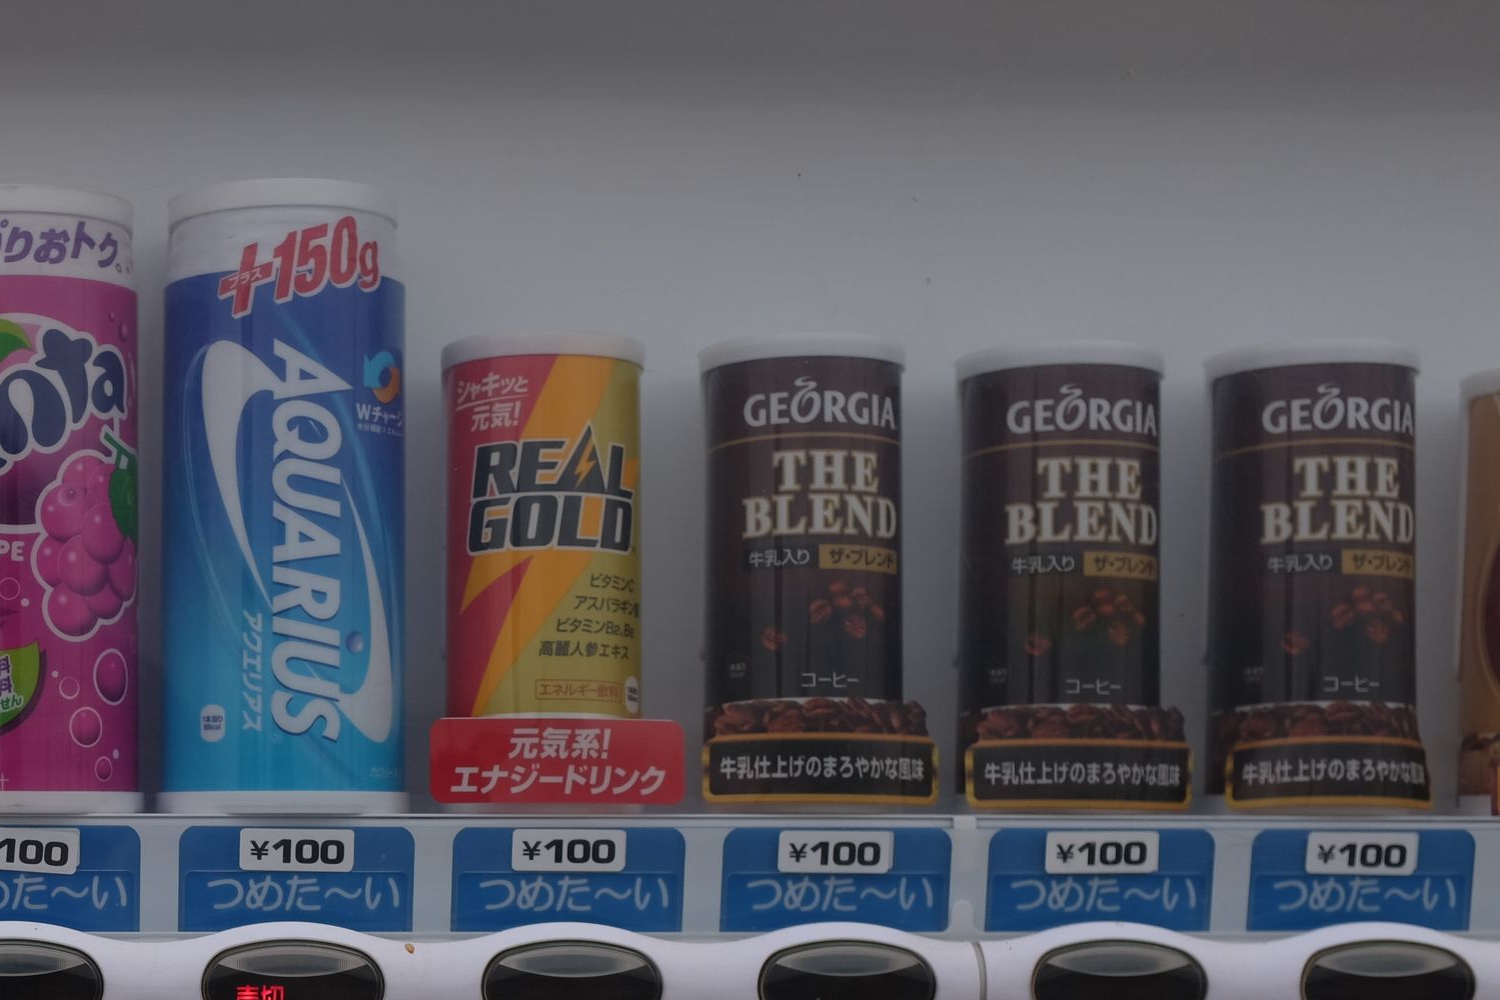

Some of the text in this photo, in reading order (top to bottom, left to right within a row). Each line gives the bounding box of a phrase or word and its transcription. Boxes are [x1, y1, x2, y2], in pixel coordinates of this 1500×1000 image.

[457, 372, 529, 404] シャキッと
[743, 376, 897, 428] GEORGIA
[1006, 384, 1157, 436] GEORGIA
[1261, 383, 1414, 436] GEORGIA
[472, 420, 634, 499] REAL
[772, 449, 879, 493] THE
[1037, 456, 1142, 499] THE
[1294, 456, 1399, 498] THE
[467, 492, 634, 555] GOLD
[741, 497, 898, 539] BLEND
[1005, 503, 1157, 546] BLEND
[1260, 502, 1414, 545] BLEND
[270, 339, 353, 743] AQUARIUS
[749, 548, 810, 567] 牛乳入り
[1011, 555, 1075, 574] 牛乳入り
[1267, 554, 1332, 573] 牛乳入り
[539, 640, 628, 660] 高麗人参エキス
[243, 609, 263, 731] アクエリアス
[801, 673, 859, 688] コーヒー
[539, 683, 620, 699] エネルギー飲料
[1065, 680, 1122, 695] コーヒー
[1323, 677, 1379, 693] コーヒー
[450, 766, 667, 795] エナジードリンク
[719, 755, 924, 782] 牛乳仕上げのまろやかな風味
[984, 762, 1181, 786] 牛乳仕上げのまろやかな風味
[250, 839, 345, 865] ¥100
[522, 839, 616, 864] ¥100
[787, 841, 881, 866] ¥100
[1056, 842, 1147, 866] ¥100
[1317, 843, 1407, 868] ¥100
